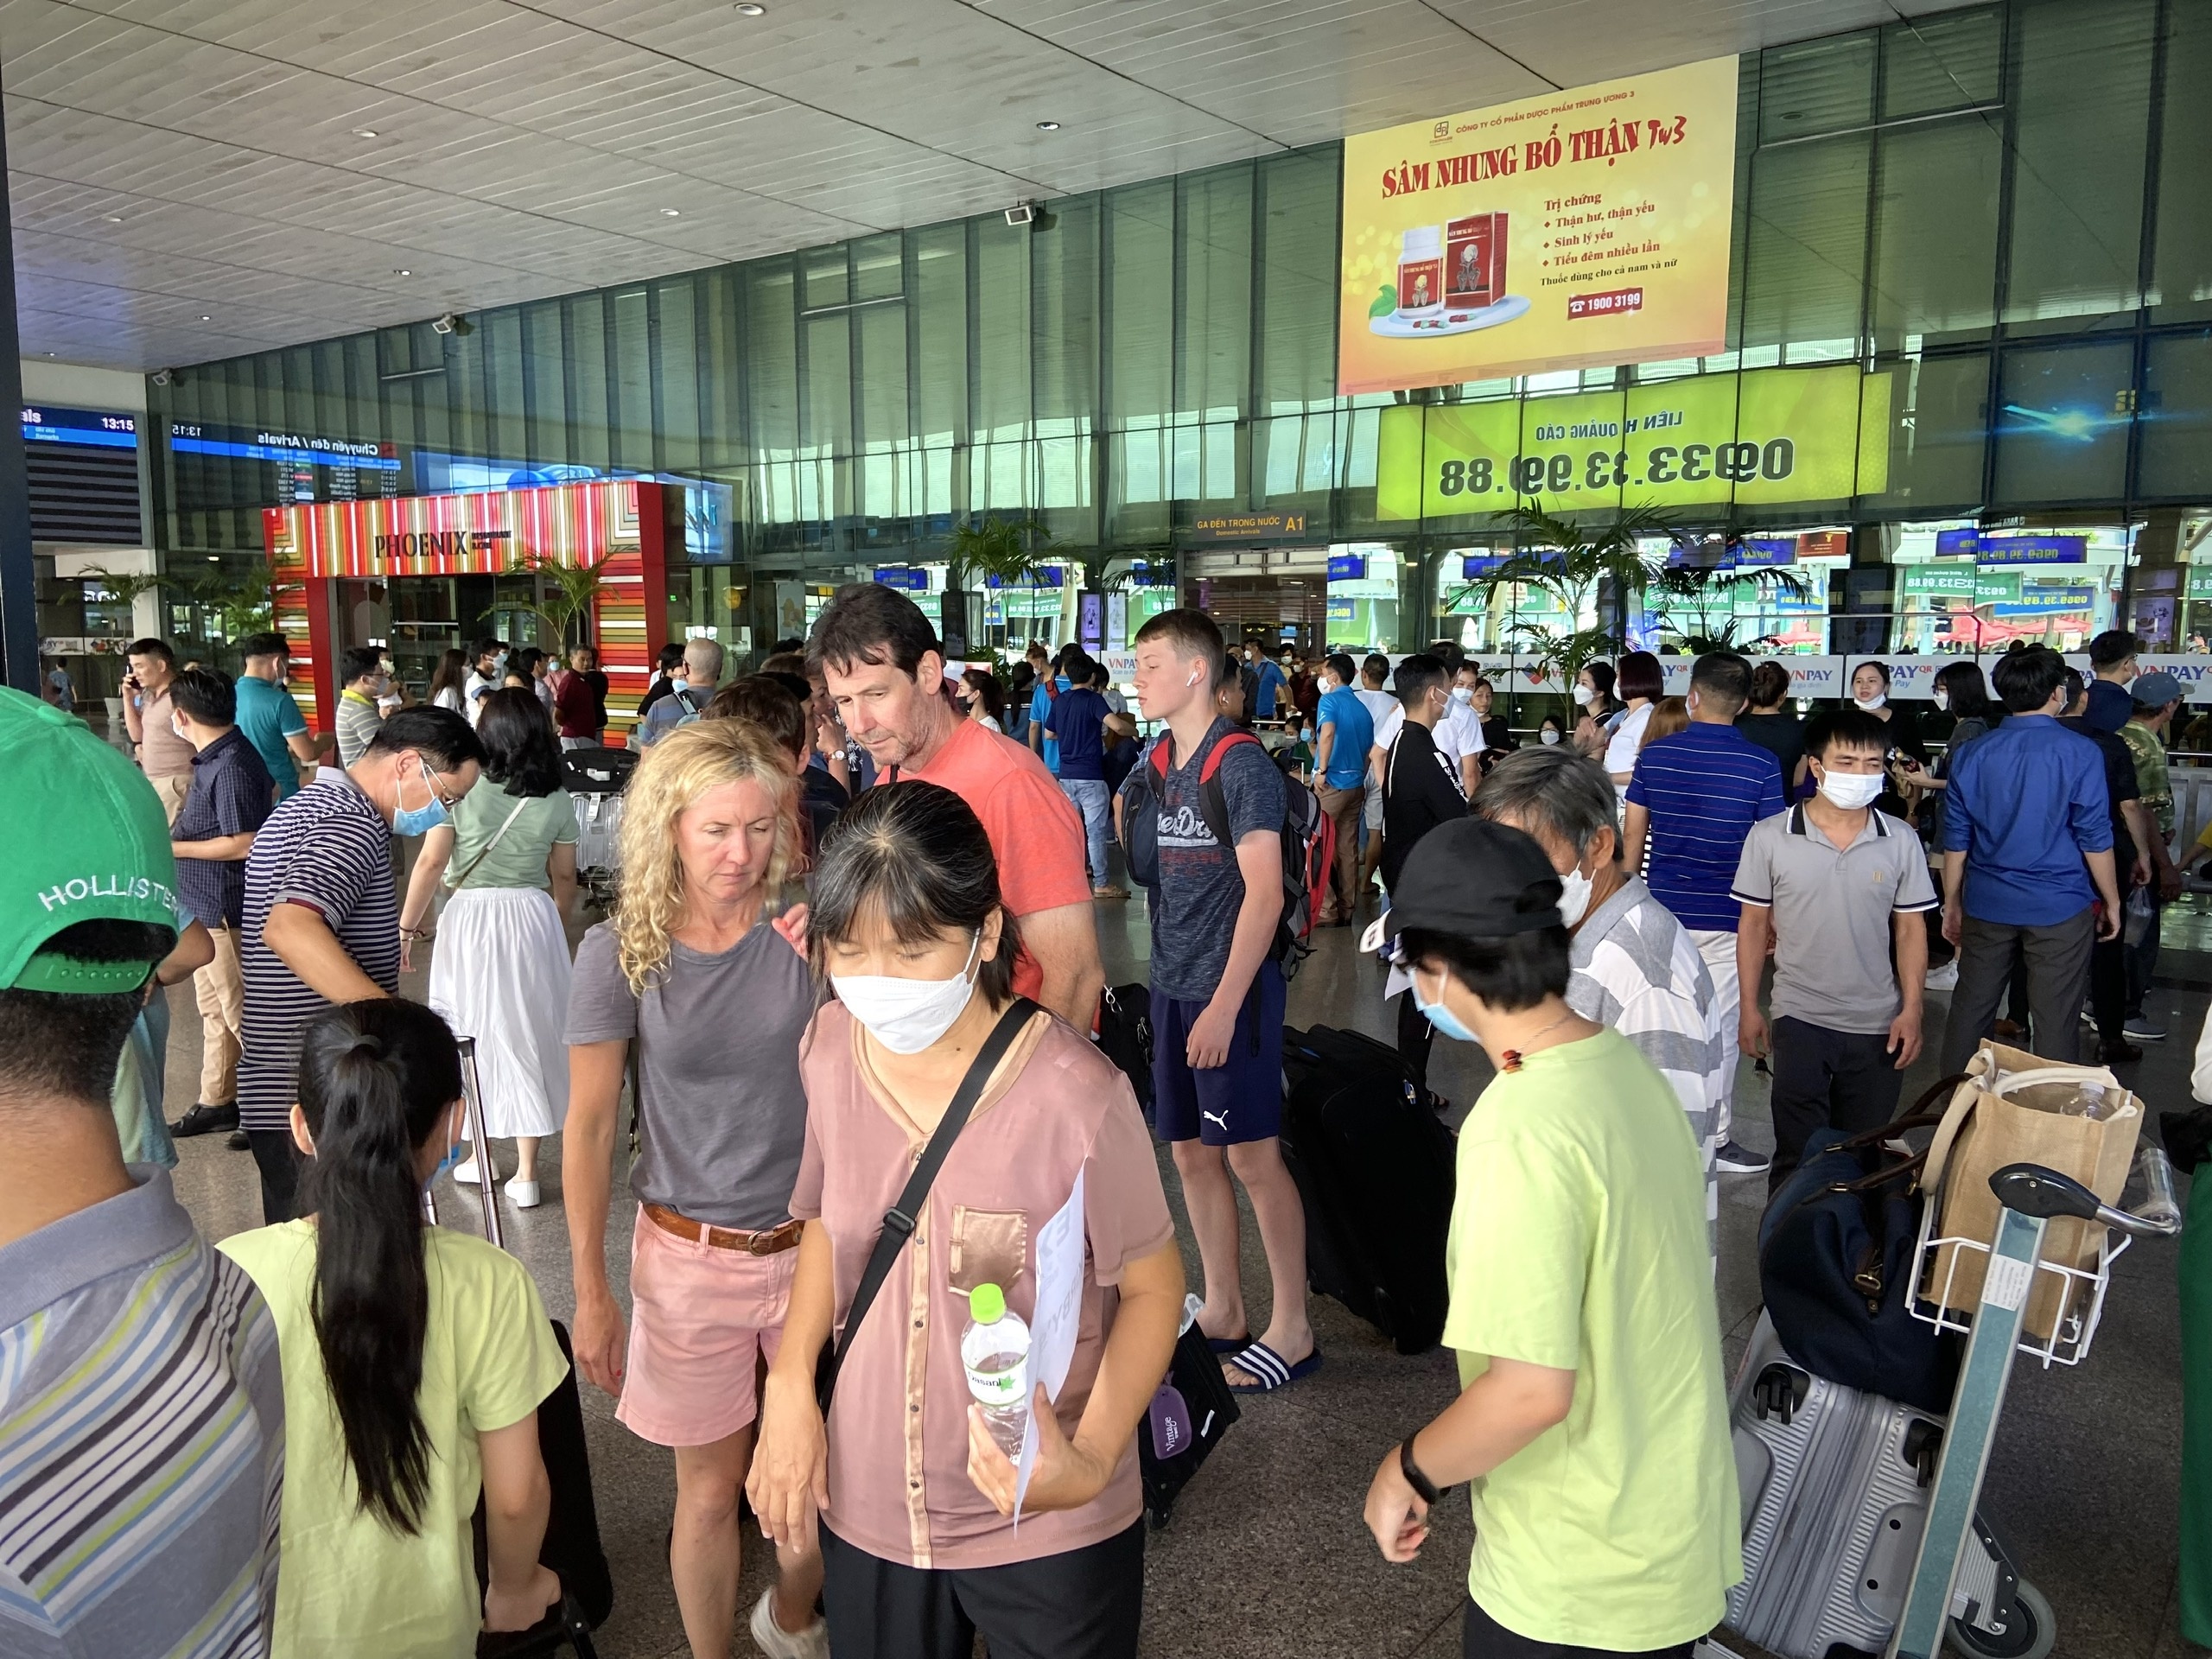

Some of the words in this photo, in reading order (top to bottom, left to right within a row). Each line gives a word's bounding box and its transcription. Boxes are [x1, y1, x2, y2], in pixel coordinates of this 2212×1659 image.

[1455, 123, 1478, 134] CÔNG
[1479, 120, 1489, 130] TY
[1575, 97, 1602, 109] TRUNG
[1382, 160, 1431, 200] SÂM
[1434, 144, 1518, 188] NHUNG
[1524, 123, 1562, 171] BỔ
[1568, 118, 1642, 167] THẬN
[1544, 198, 1561, 213] Trị
[1564, 193, 1602, 208] chứng
[1555, 215, 1584, 228] Thận
[1586, 212, 1605, 223] hư,
[1607, 206, 1633, 220] thận
[1635, 200, 1656, 217] yếu
[1554, 234, 1580, 248] Sinh
[1583, 232, 1592, 245] lý
[1594, 227, 1613, 245] yếu
[1554, 251, 1578, 267] Tiểu
[1580, 248, 1604, 263] đêm
[1606, 242, 1638, 259] nhiều
[1642, 238, 1661, 253] lần
[1540, 271, 1568, 286] Thuốc
[1570, 270, 1593, 283] dùng
[1595, 268, 1612, 278] cho
[1614, 264, 1625, 275] cả
[1627, 264, 1649, 274] nam
[1651, 259, 1661, 270] và
[1663, 258, 1678, 269] nữ
[1587, 296, 1612, 311] 1900
[1614, 292, 1641, 308] 3199
[101, 416, 134, 431] 13:15
[1197, 521, 1209, 530] GA
[1228, 518, 1255, 528] TRONG
[1257, 515, 1281, 526] NƯỚC
[1285, 516, 1304, 531] A1
[374, 531, 468, 558] PHOENIX
[1109, 658, 1135, 669] VNPA
[1889, 666, 1919, 678] PAY
[1789, 670, 1833, 681] VNPAY
[1895, 679, 1910, 688] Pay
[1164, 1416, 1178, 1452] Vintage
